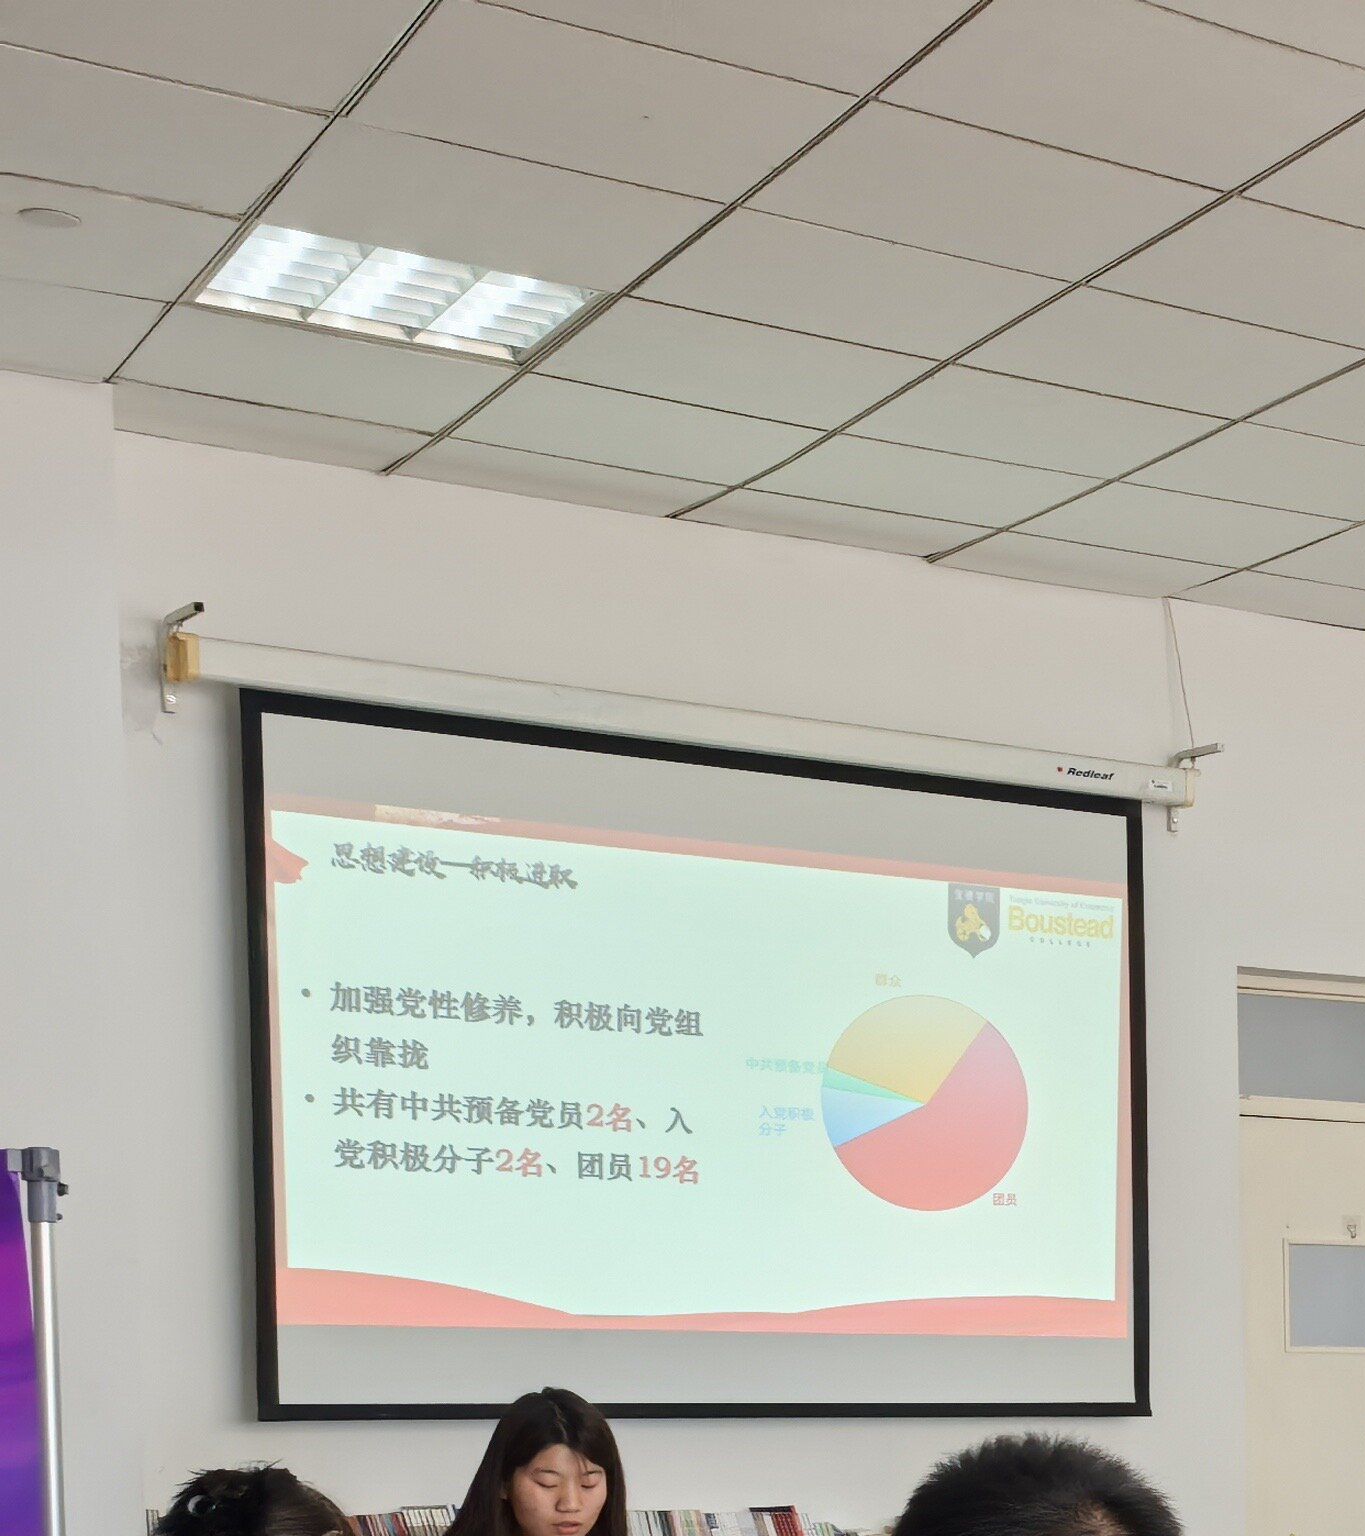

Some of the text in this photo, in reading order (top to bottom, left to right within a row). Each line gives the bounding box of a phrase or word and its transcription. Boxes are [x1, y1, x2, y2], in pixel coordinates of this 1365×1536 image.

[1066, 767, 1115, 781] Redleaf
[1008, 905, 1115, 939] Boustead
[330, 982, 704, 1036] 加强党性修养，积极向党组
[331, 1034, 430, 1070] 织靠拢
[992, 1192, 1018, 1206] 团员
